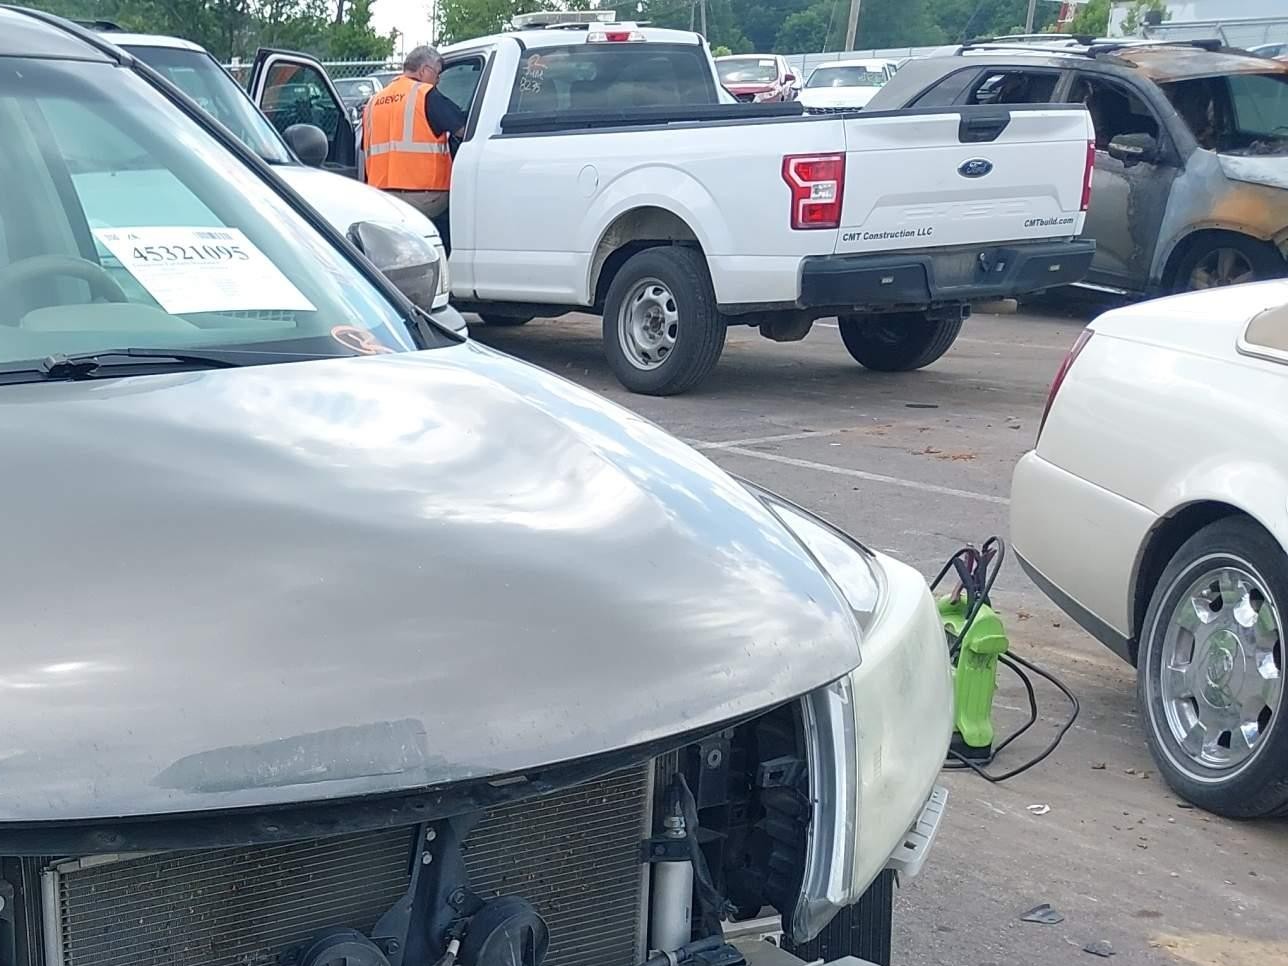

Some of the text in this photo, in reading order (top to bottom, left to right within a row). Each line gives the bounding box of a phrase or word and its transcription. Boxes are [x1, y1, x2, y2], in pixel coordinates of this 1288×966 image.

[374, 93, 406, 106] AGENCY
[1024, 217, 1074, 227] CMTbuild.com
[842, 227, 933, 241] CMT Construction LLC
[132, 245, 250, 262] 45321095
